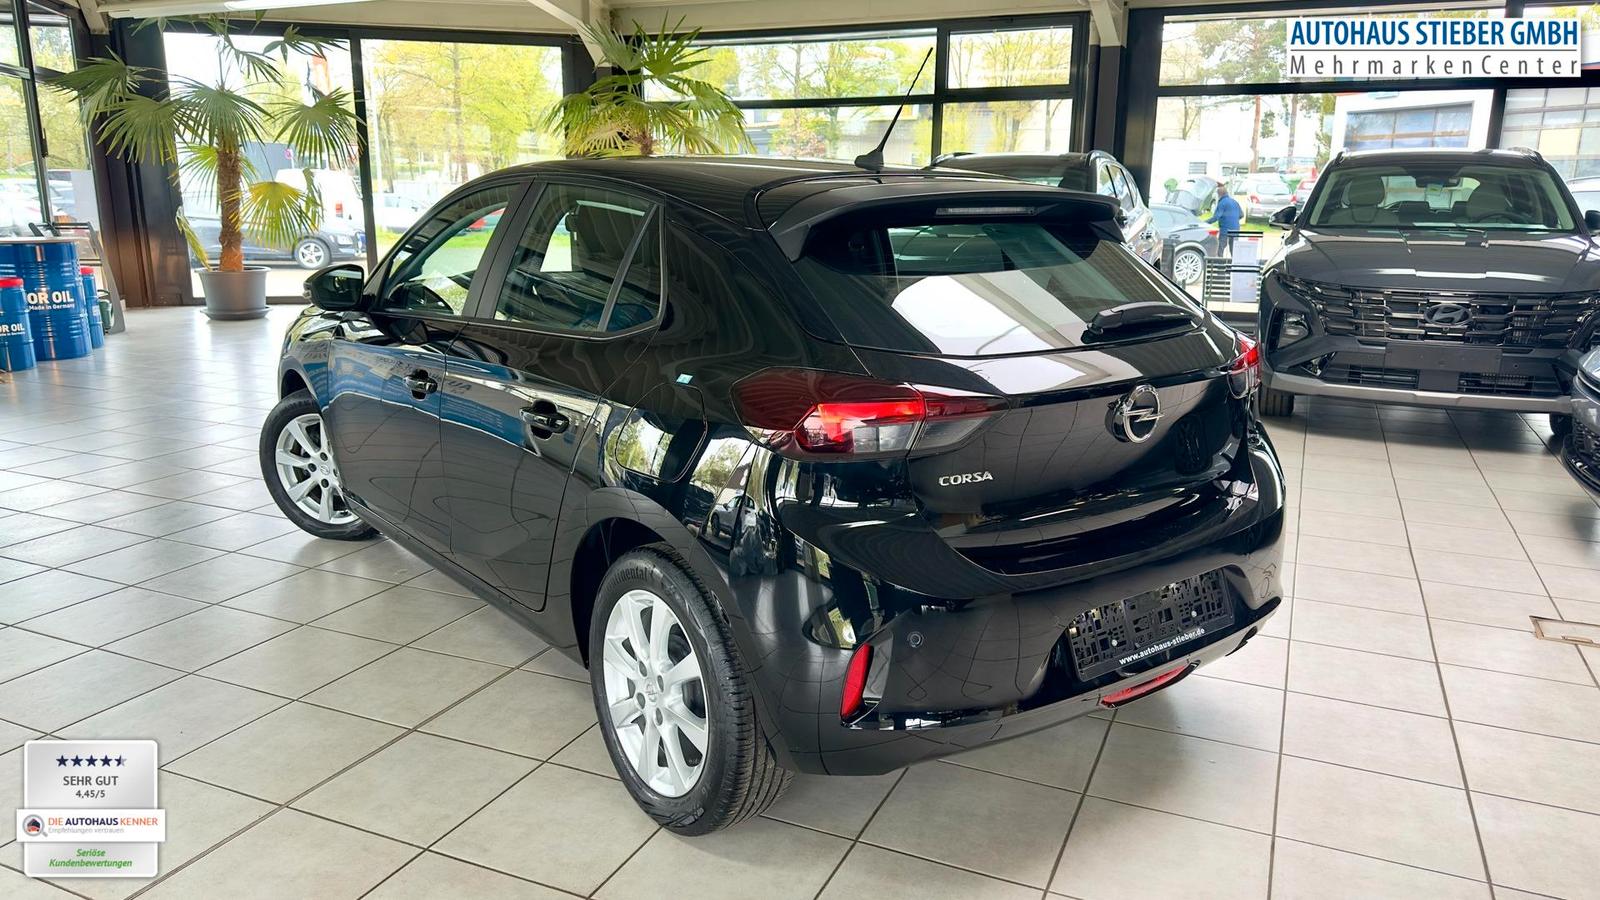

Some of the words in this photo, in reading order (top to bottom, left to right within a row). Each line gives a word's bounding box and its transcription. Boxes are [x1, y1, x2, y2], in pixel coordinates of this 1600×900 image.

[52, 290, 75, 304] OIL
[10, 323, 26, 332] OIL
[938, 470, 994, 487] CORSA
[1118, 627, 1205, 665] www.autohaus-stieber.de
